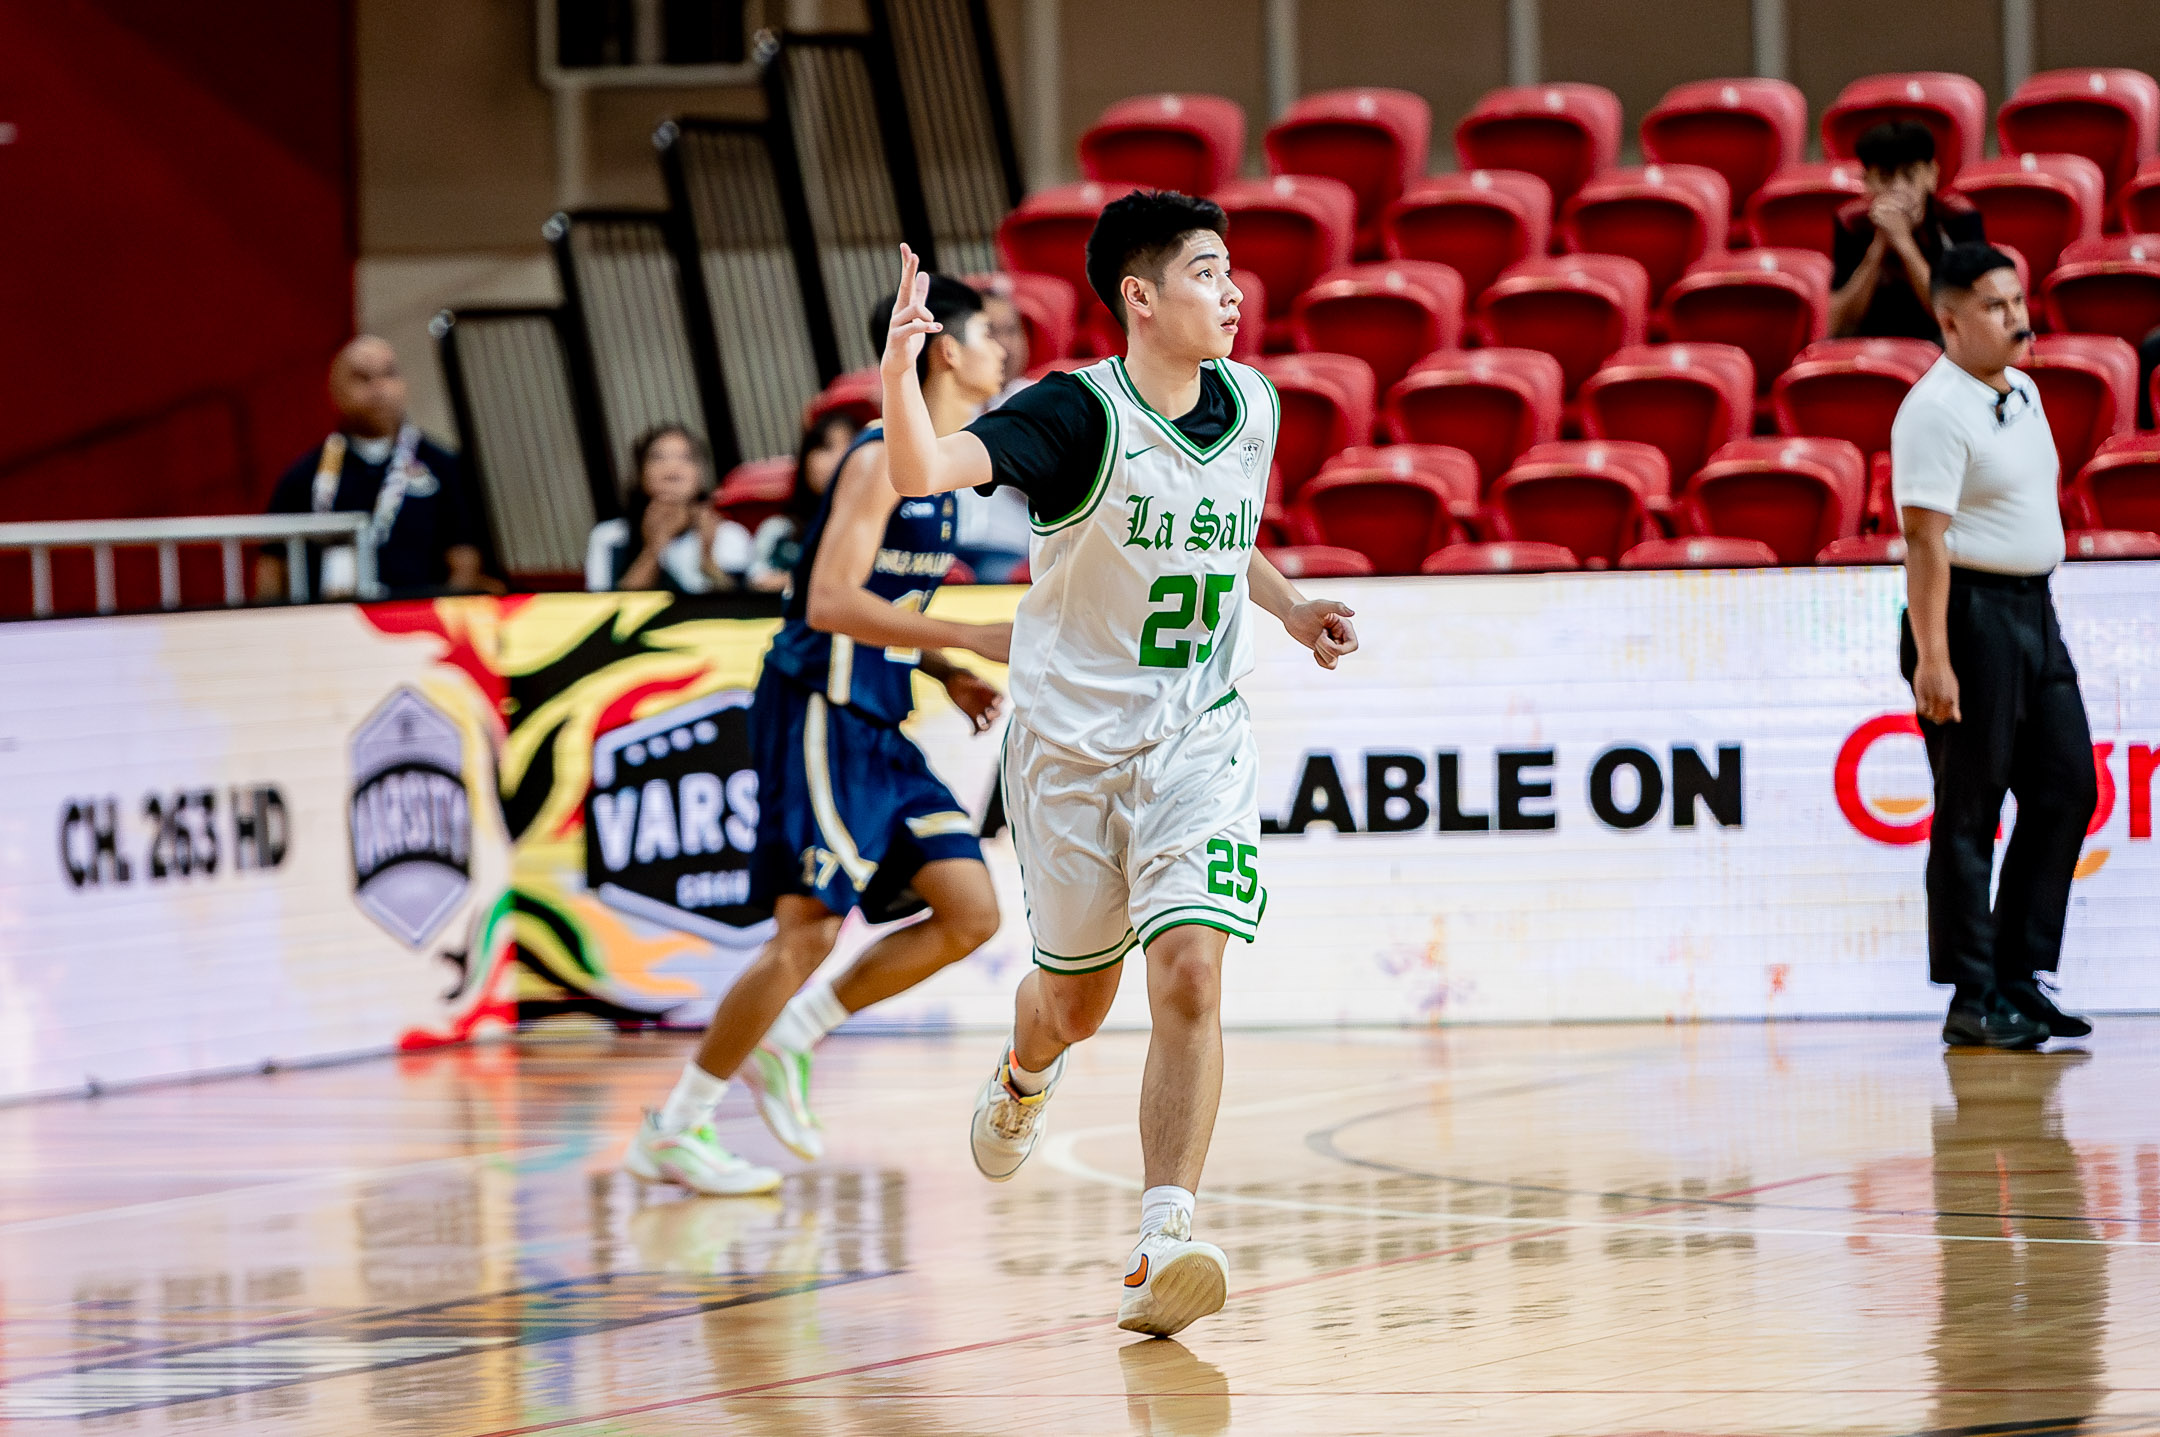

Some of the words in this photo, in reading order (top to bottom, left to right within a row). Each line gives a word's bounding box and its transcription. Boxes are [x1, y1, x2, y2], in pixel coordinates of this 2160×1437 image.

[1123, 494, 1176, 550] La
[1138, 573, 1236, 668] 25
[229, 784, 288, 870] HD
[592, 768, 760, 872] VARS
[1589, 745, 1742, 829] ON
[801, 845, 841, 890] 17
[1206, 837, 1258, 905] 25
